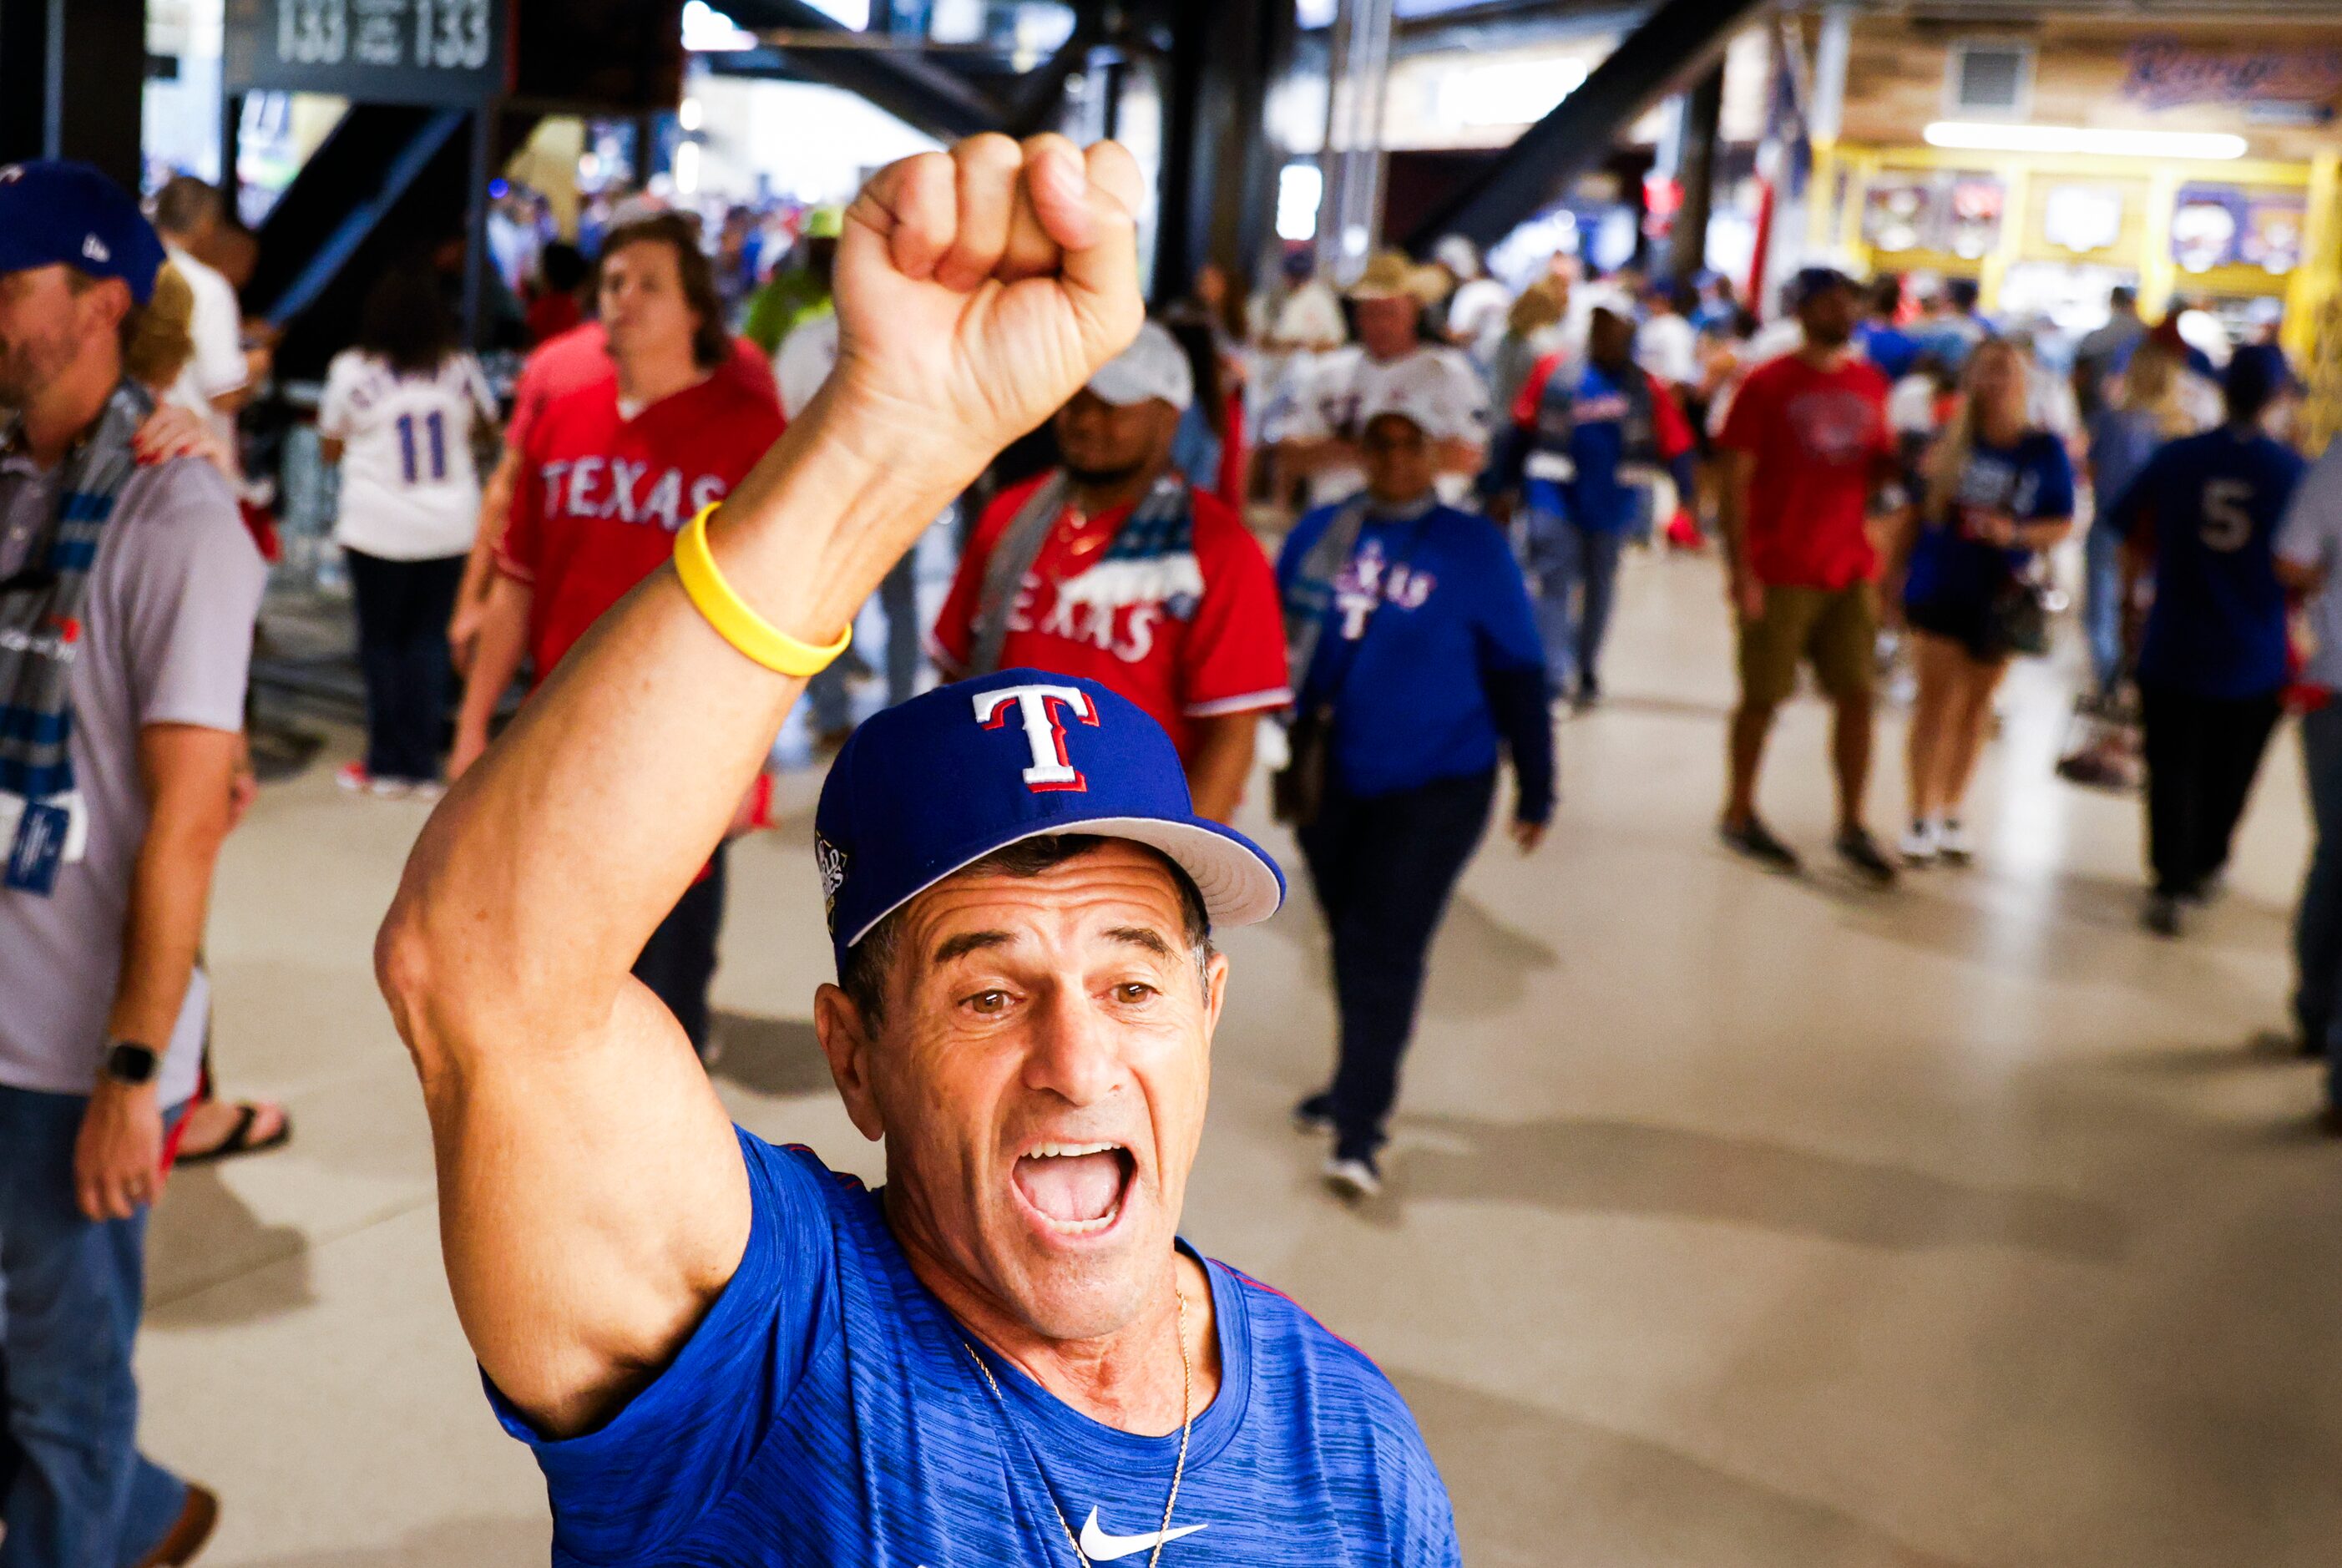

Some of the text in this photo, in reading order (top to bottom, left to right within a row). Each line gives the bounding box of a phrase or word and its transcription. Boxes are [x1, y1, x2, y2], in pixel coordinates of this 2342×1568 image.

[396, 412, 446, 484] 11
[2198, 478, 2254, 554] 5
[972, 683, 1100, 793] T
